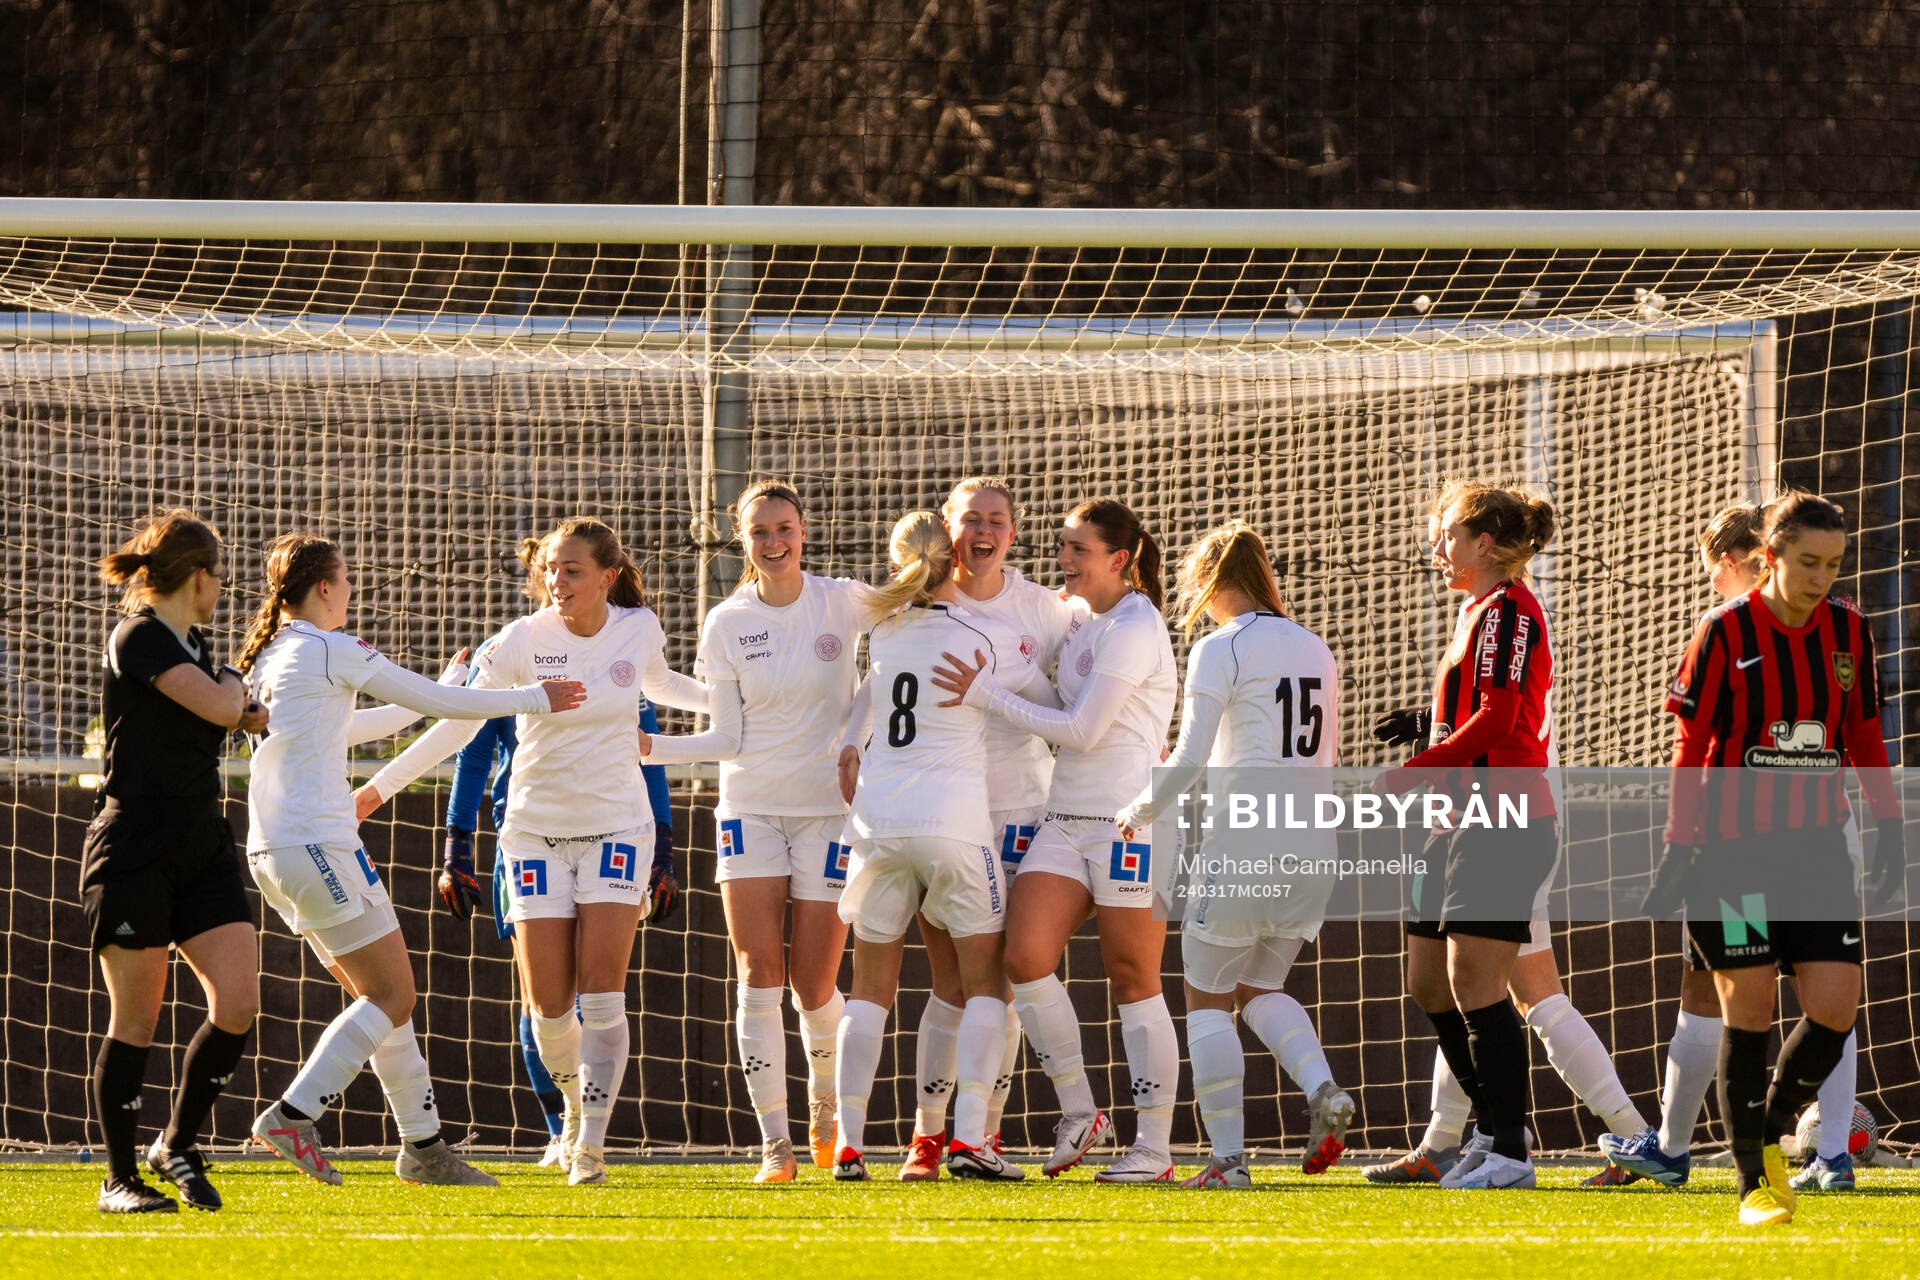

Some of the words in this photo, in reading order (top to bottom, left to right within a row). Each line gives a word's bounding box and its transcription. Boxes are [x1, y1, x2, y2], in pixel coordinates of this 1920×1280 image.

[534, 653, 568, 664] brand
[1481, 608, 1500, 677] stadium
[1509, 614, 1529, 682] stadium
[888, 672, 918, 748] 8
[1276, 677, 1323, 758] 15
